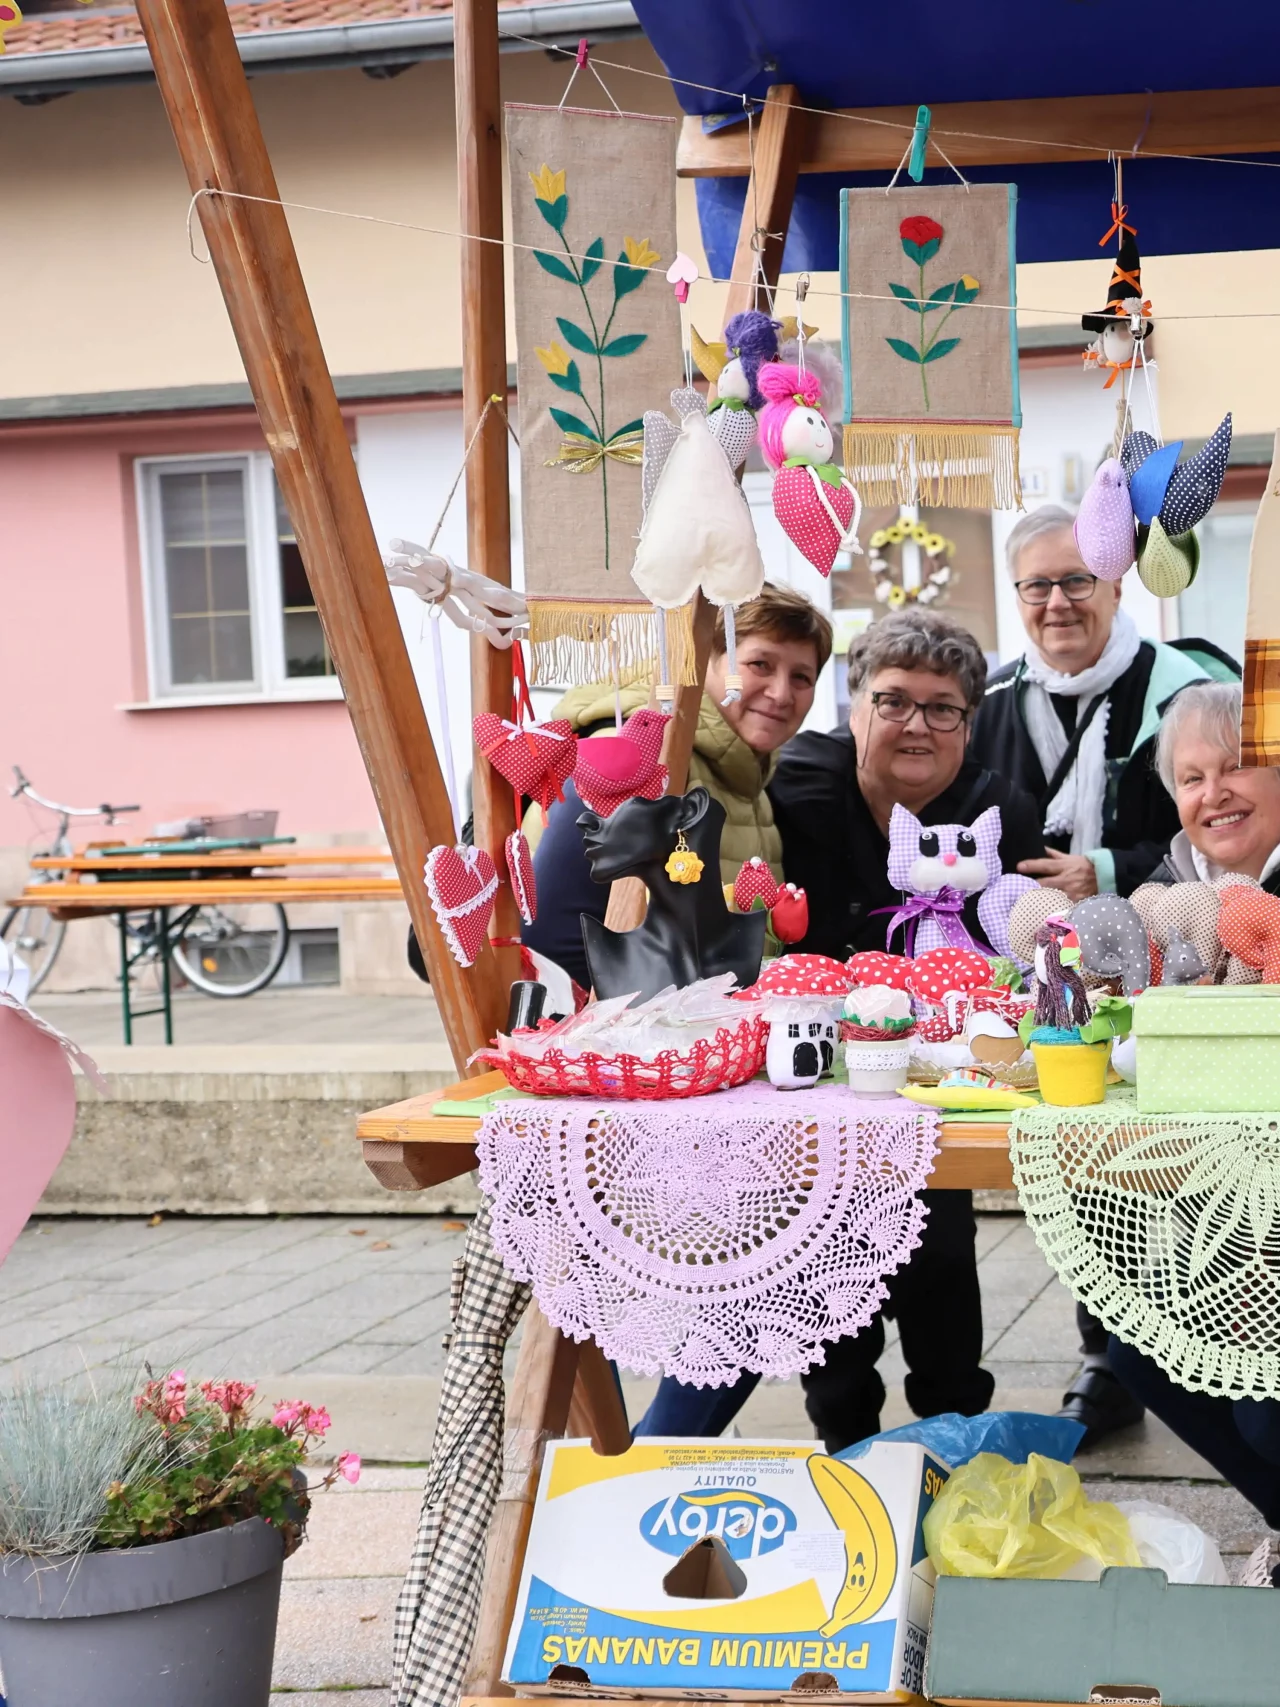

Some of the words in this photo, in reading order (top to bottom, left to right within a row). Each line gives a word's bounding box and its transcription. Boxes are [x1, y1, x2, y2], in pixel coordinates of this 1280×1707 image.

[694, 1475, 757, 1487] QUALITY
[650, 1494, 786, 1558] derby
[541, 1634, 700, 1666] BANANAS
[711, 1638, 870, 1669] PREMIUM
[903, 1642, 925, 1671] ADOR
[900, 1665, 912, 1687] OF
